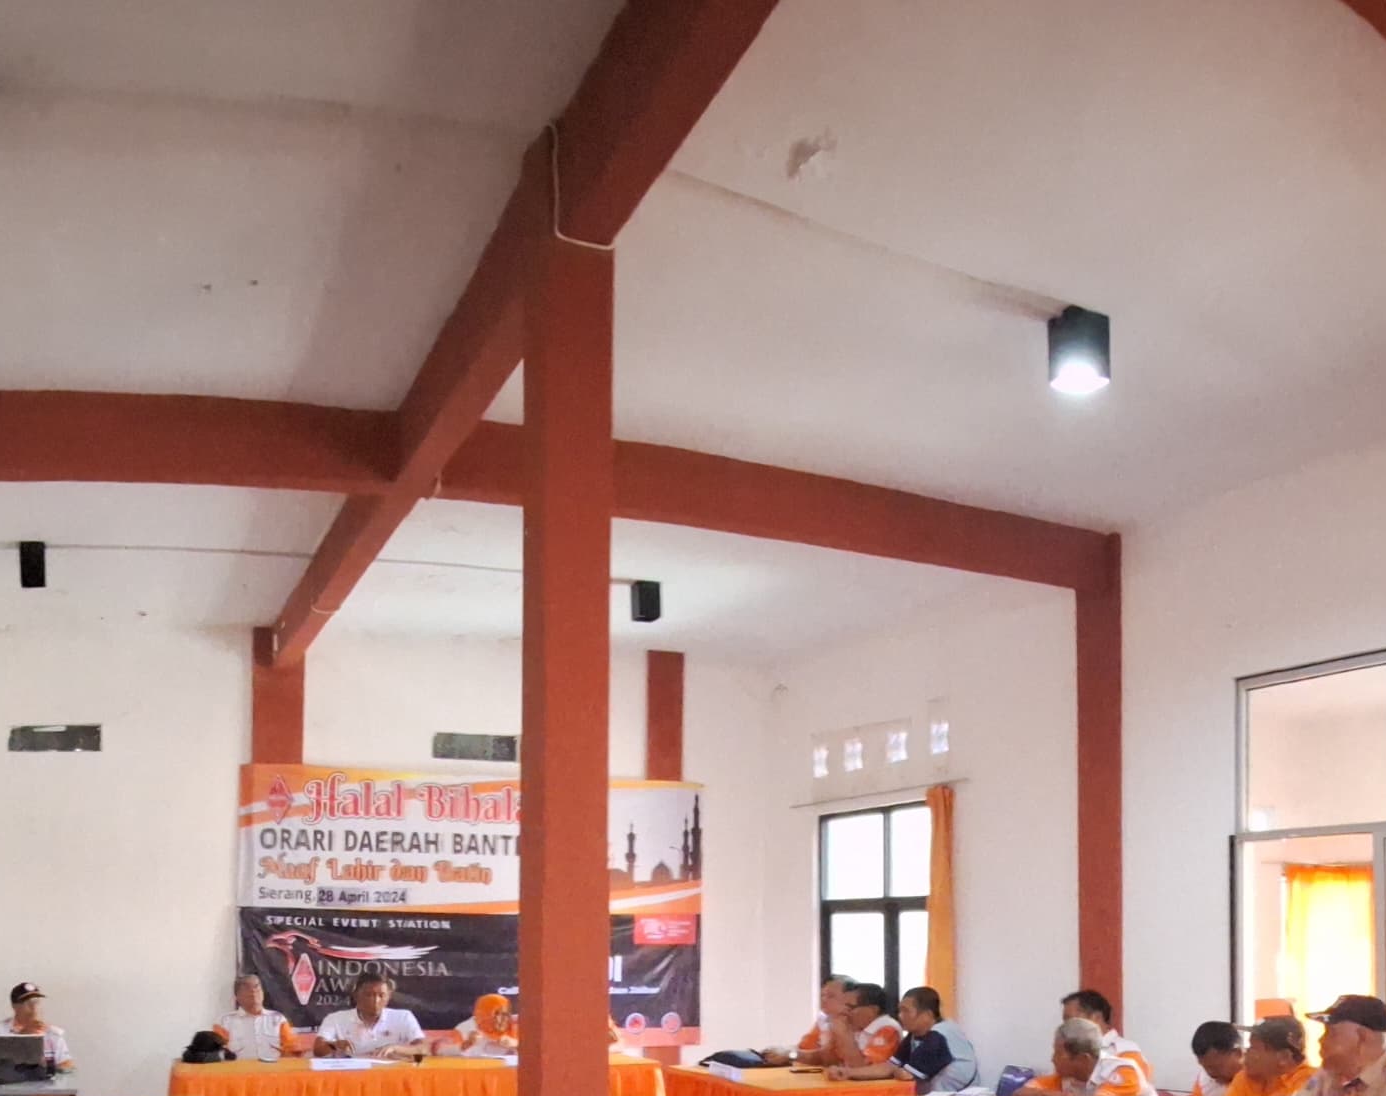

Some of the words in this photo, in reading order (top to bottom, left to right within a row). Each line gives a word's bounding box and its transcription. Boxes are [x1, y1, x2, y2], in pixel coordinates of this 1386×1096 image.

[303, 772, 405, 824] Halal
[260, 827, 334, 851] ORARI
[345, 830, 439, 854] DAERAH
[326, 857, 387, 882] Lahir
[389, 858, 429, 883] dan
[433, 859, 493, 885] Batin
[318, 889, 333, 902] 28
[338, 890, 369, 904] April
[373, 890, 407, 903] 2024
[265, 915, 325, 927] SPECIAL
[332, 917, 378, 928] EVENT
[388, 919, 452, 930] STATION
[317, 959, 450, 977] INDONESIA
